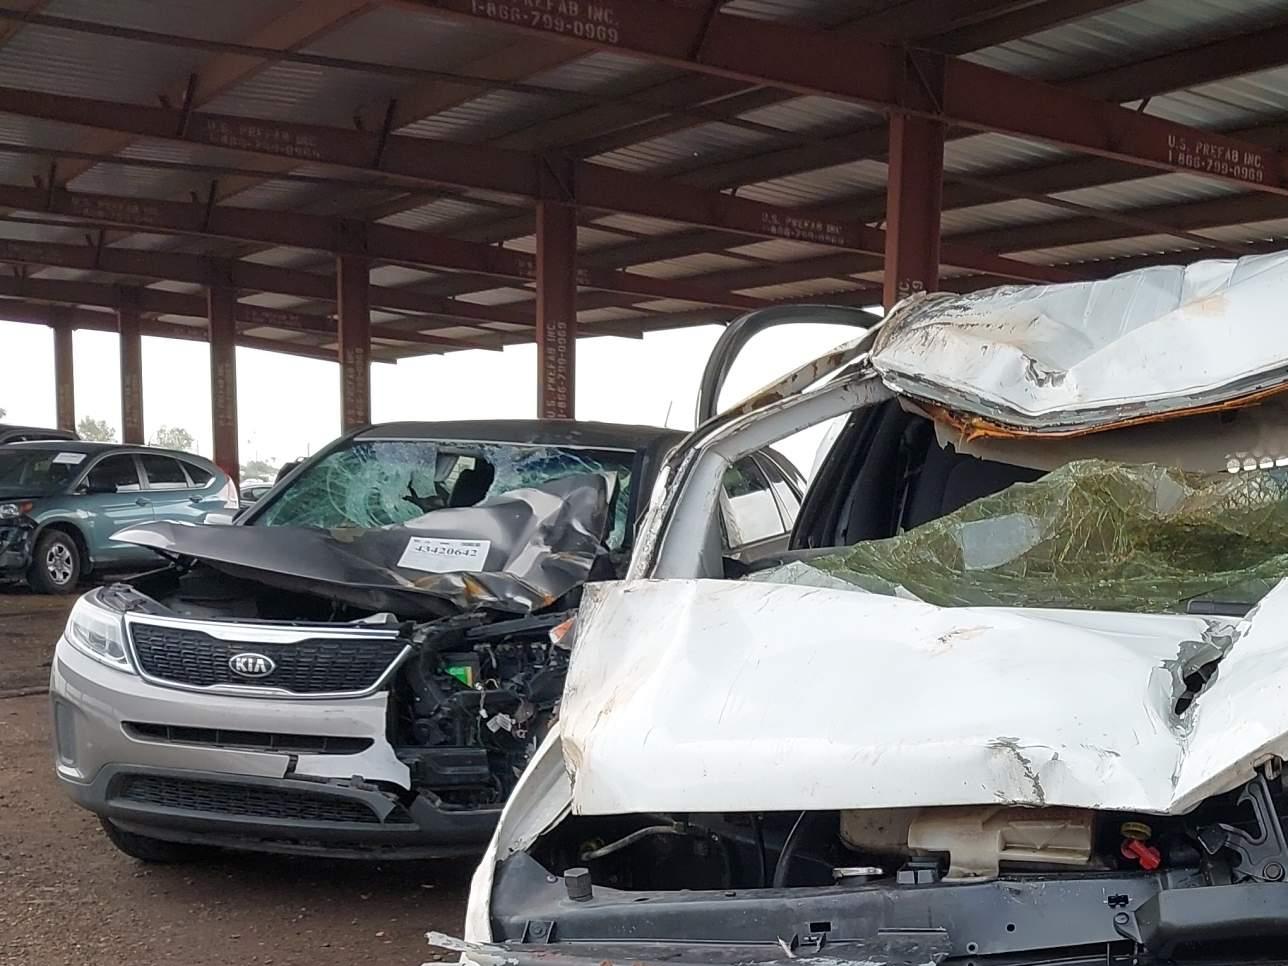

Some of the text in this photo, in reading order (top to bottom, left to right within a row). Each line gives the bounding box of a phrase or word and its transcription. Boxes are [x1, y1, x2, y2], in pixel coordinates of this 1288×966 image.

[523, 0, 579, 16] EFAB
[1195, 141, 1239, 163] PREFAB
[1243, 151, 1265, 168] INC.
[1168, 149, 1263, 182] 1866-799-0969
[415, 545, 478, 557] 43420642
[235, 657, 268, 673] KIA
